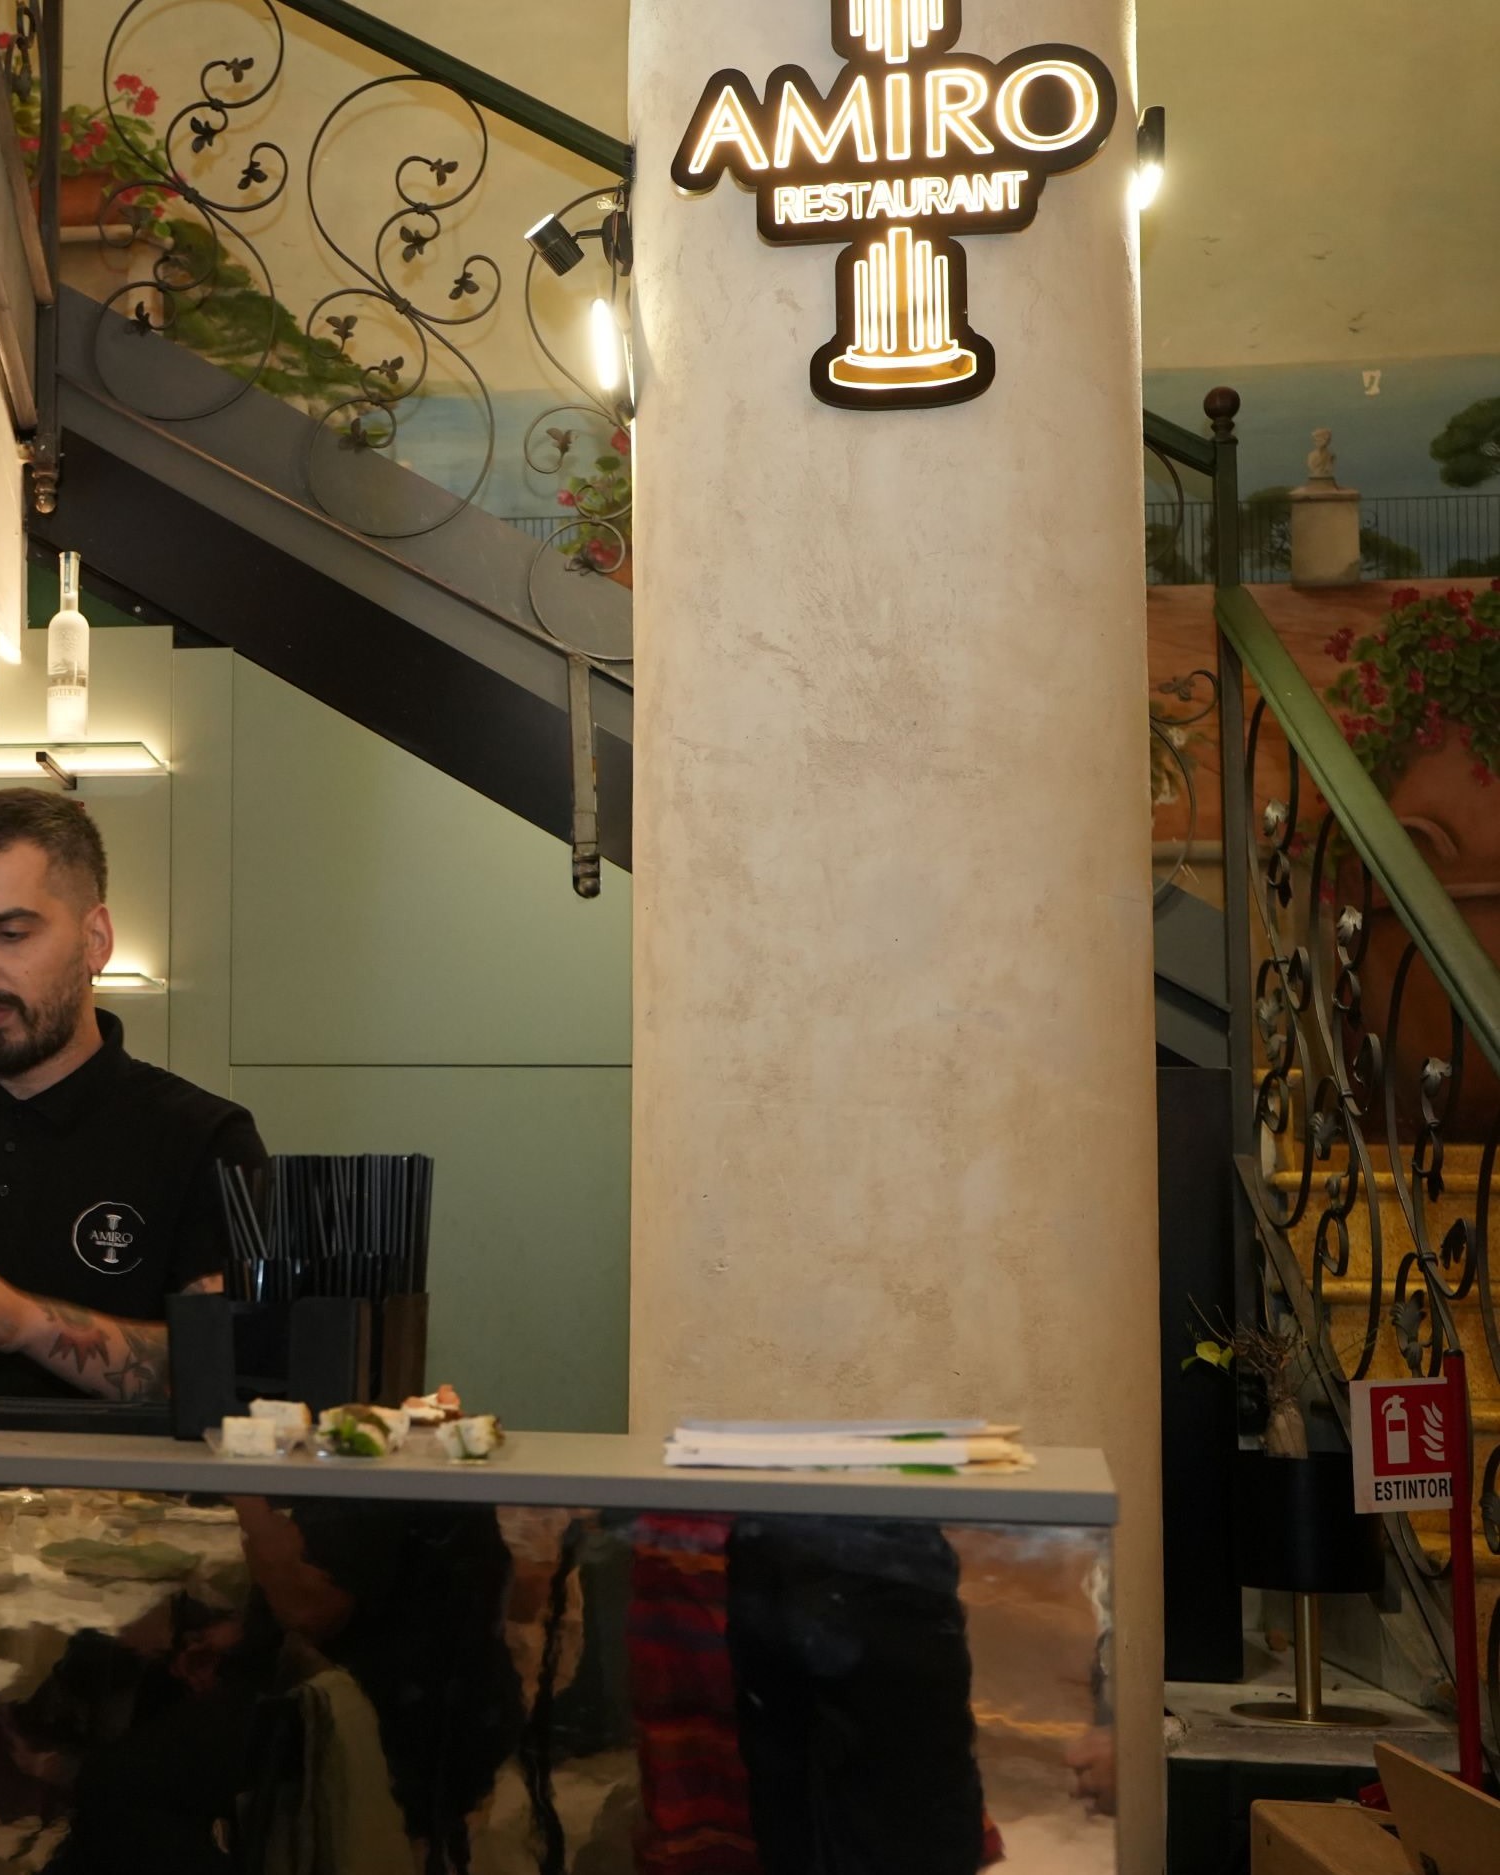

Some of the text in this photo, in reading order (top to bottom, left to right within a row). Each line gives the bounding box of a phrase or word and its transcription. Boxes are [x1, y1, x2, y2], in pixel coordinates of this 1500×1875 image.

[688, 59, 1100, 174] AMIRO
[773, 171, 1029, 225] RESTAURANT
[89, 1230, 134, 1244] AMIRO
